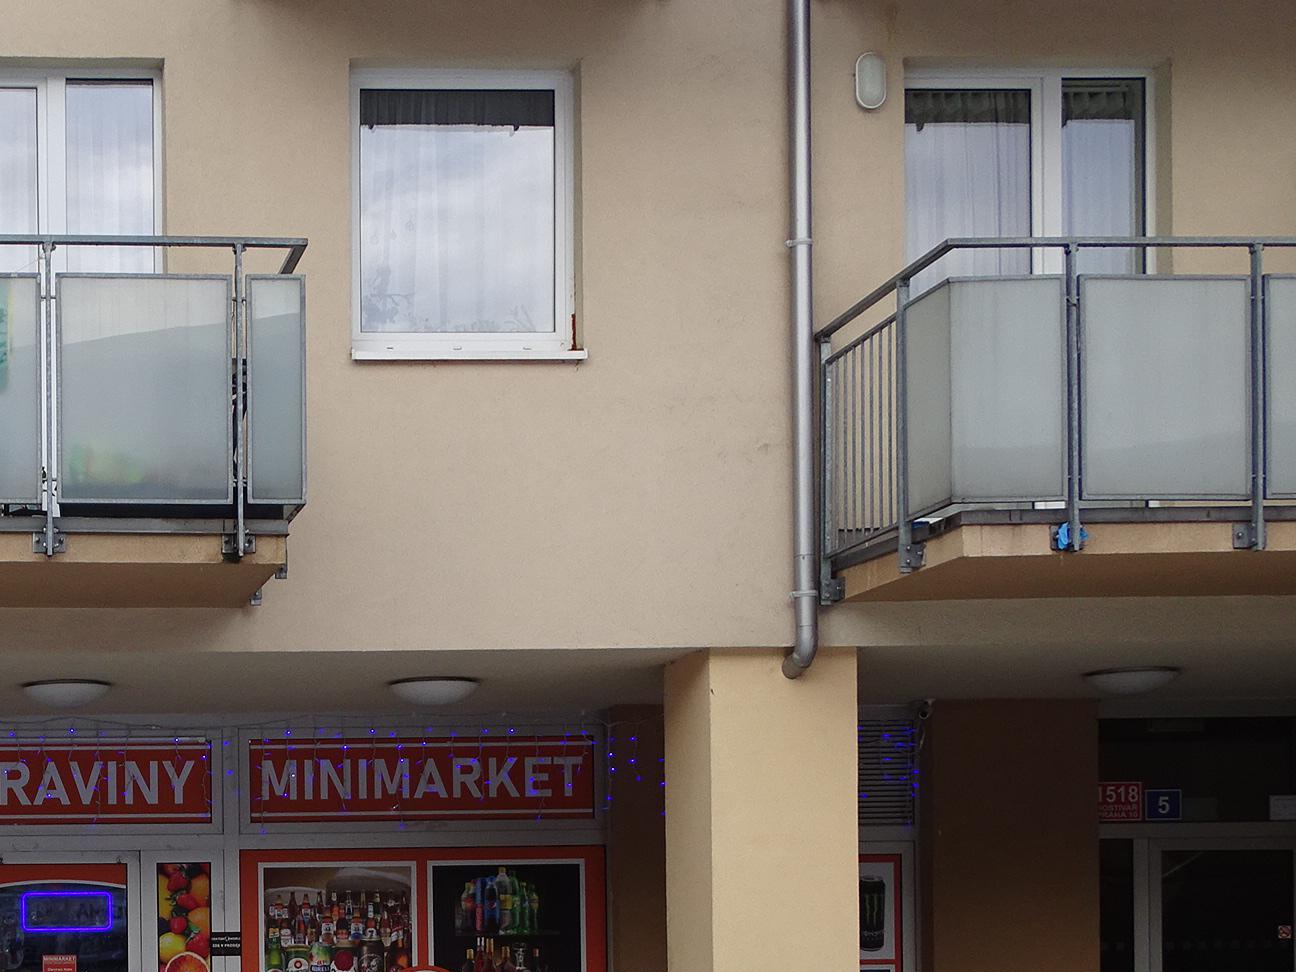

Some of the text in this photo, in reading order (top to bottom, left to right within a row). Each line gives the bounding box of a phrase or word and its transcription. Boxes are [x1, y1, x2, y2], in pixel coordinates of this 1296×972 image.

[262, 756, 583, 800] MINIMARKET
[1098, 785, 1139, 803] 1518
[1157, 795, 1170, 814] 5
